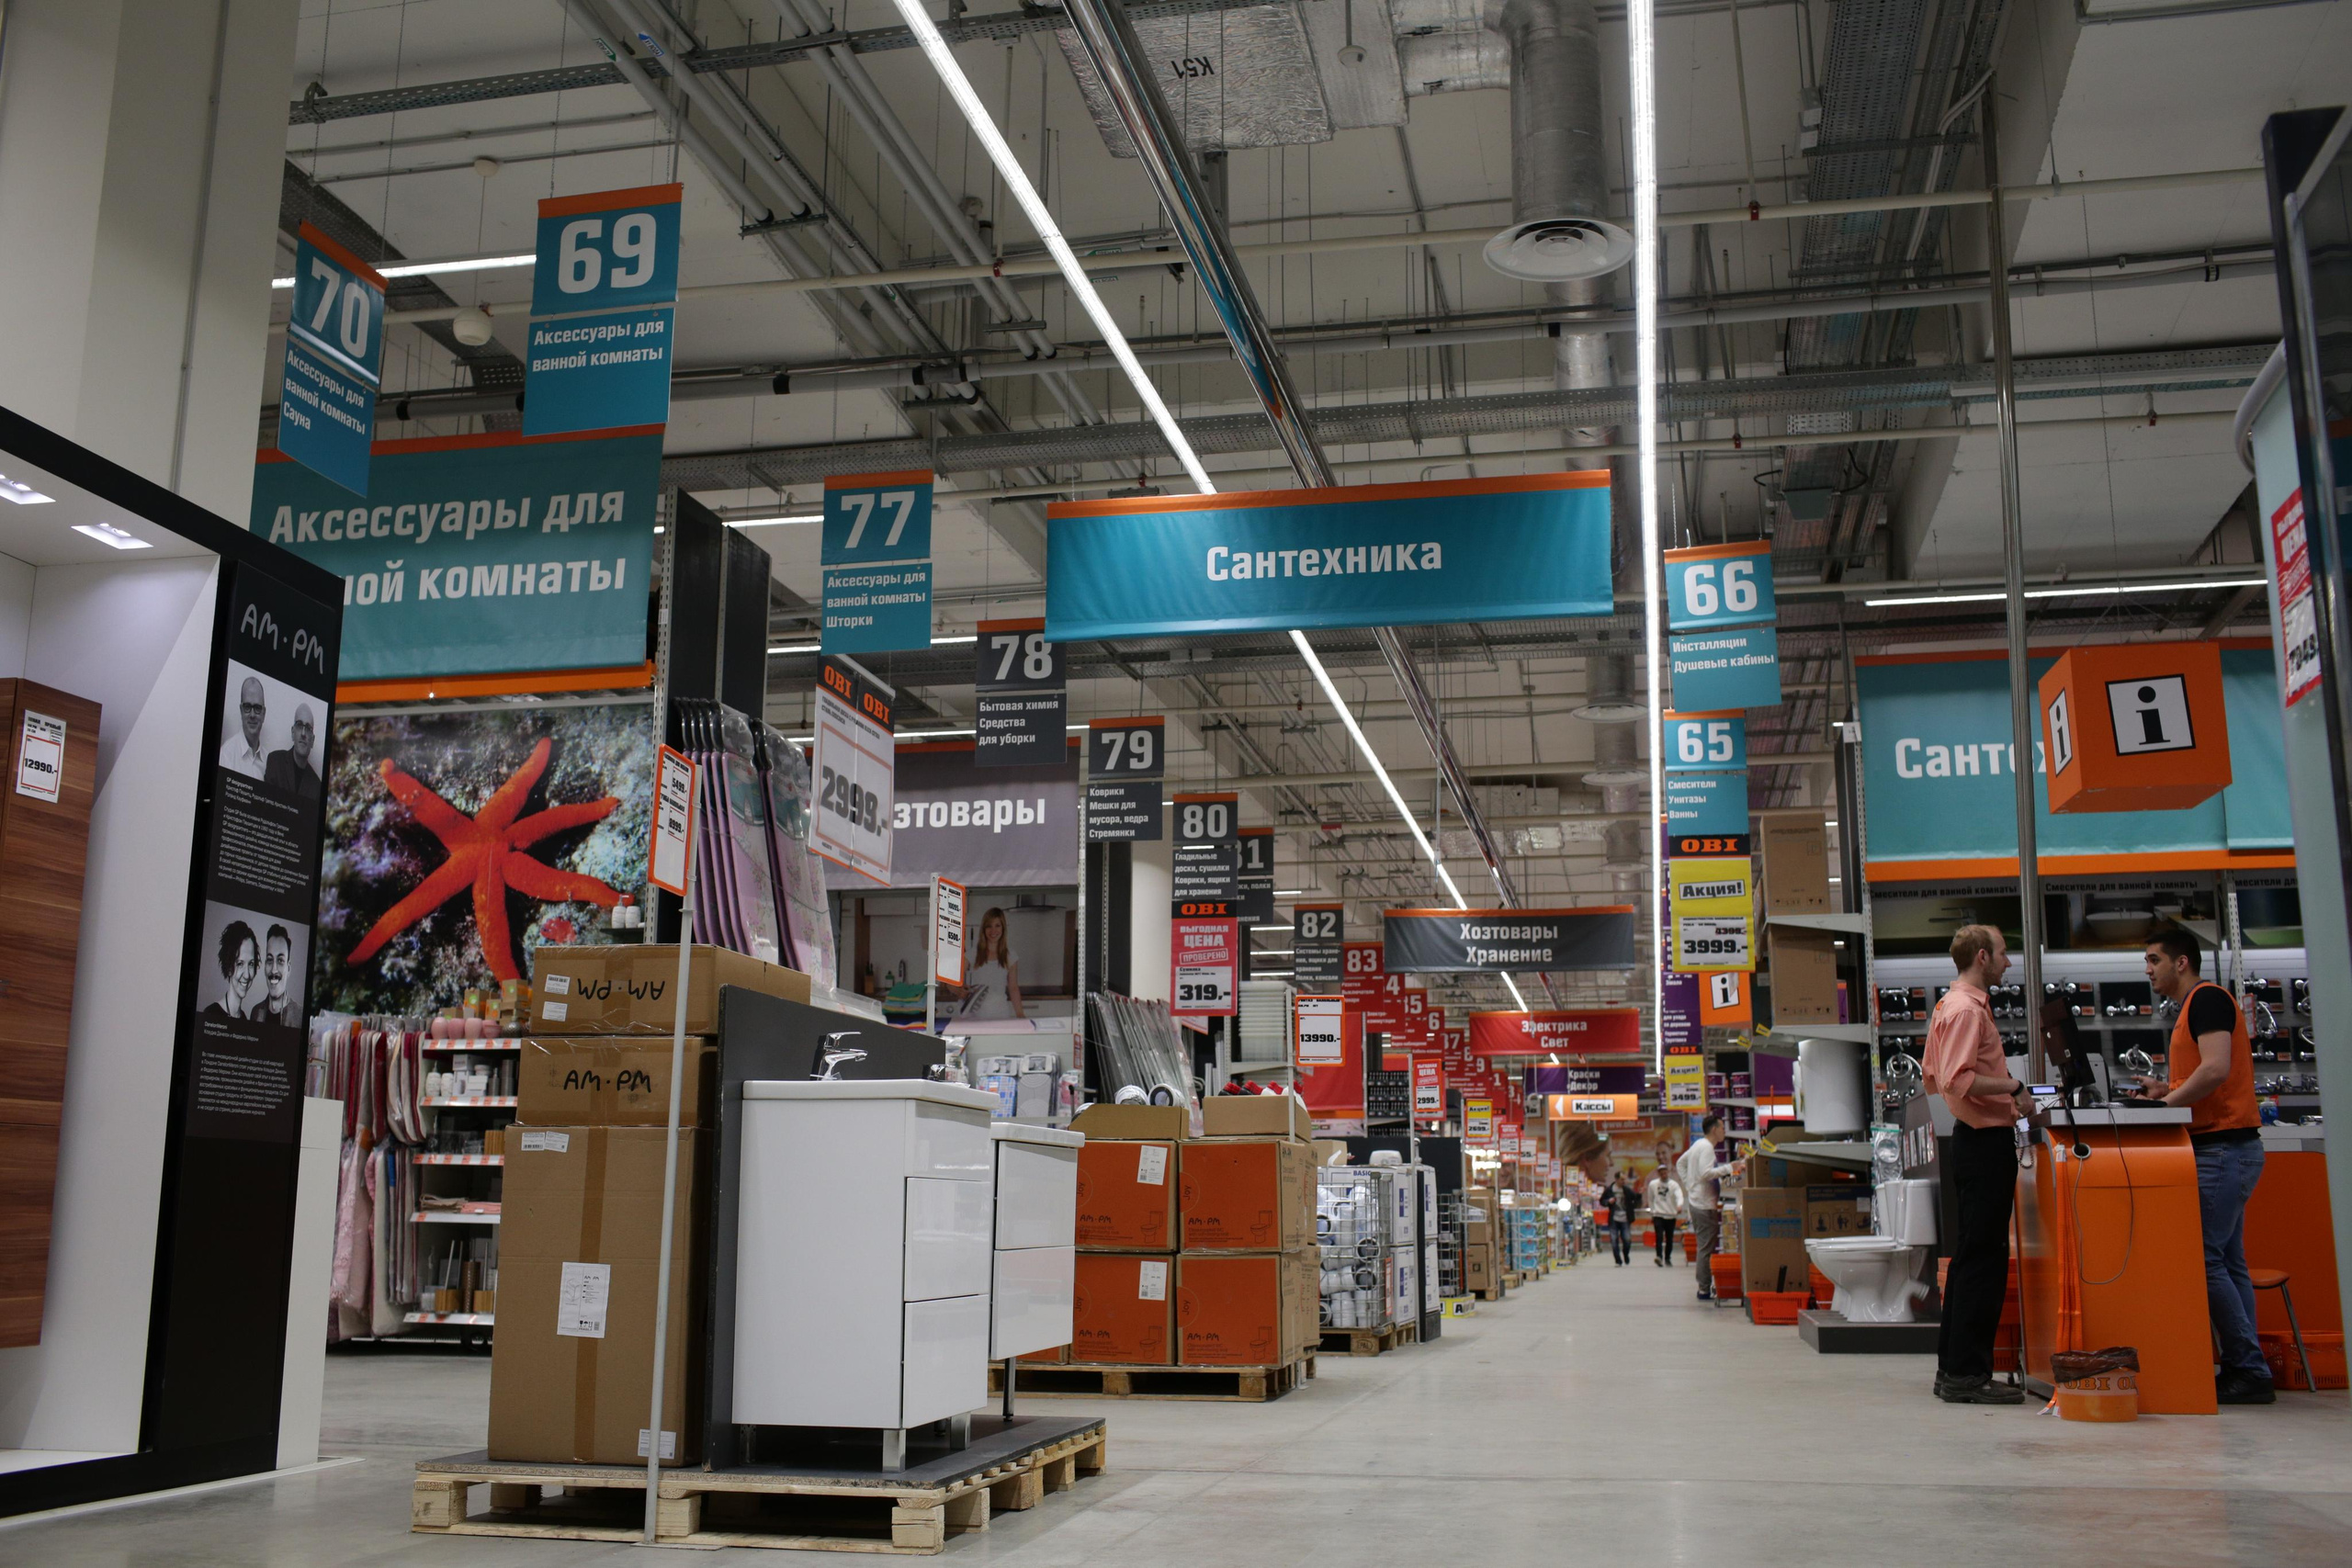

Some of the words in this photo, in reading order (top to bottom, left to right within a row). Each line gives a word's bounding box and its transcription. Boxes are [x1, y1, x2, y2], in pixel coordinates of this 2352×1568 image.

[557, 212, 657, 294] 69
[311, 256, 370, 359] 70
[533, 323, 630, 346] Аксессуары
[634, 320, 664, 338] для
[532, 348, 587, 372] ванной
[590, 345, 663, 367] комнаты
[287, 349, 345, 400] Аксессуары
[345, 388, 365, 408] для
[285, 376, 320, 408] ванной
[321, 401, 366, 435] комнаты
[283, 400, 311, 432] Сауна
[268, 497, 531, 545] Аксессуары
[541, 491, 625, 533] для
[841, 491, 915, 549] 77
[1206, 541, 1442, 582] Сантехника
[418, 558, 626, 601] комнаты
[827, 573, 900, 588] Аксессуары
[903, 571, 926, 585] для
[1683, 560, 1758, 615] 66
[827, 593, 868, 608] ванной
[871, 592, 926, 605] комнаты
[826, 615, 873, 629] Шторки
[1673, 637, 1747, 653] Инсталляции
[991, 633, 1053, 680] 78
[1674, 659, 1727, 673] Душевые
[1730, 653, 1774, 668] кабины
[824, 665, 852, 699] OBI
[864, 693, 890, 725] OBI
[979, 702, 1023, 713] Бытовая
[1025, 700, 1058, 711] химия
[979, 718, 1025, 729] Средства
[978, 736, 997, 746] для
[1000, 732, 1035, 746] уборки
[1678, 722, 1734, 762] 65
[1101, 730, 1153, 771] 79
[1090, 787, 1125, 797] Коврики
[1668, 780, 1716, 790] Смесители
[1090, 801, 1118, 810] Мешки
[1120, 800, 1136, 811] для
[1668, 795, 1706, 804] Унитазы
[894, 799, 1046, 833] зтовары
[1089, 814, 1123, 825] мусора,
[1124, 814, 1148, 824] ведра
[1182, 804, 1227, 838] 80
[1669, 810, 1698, 818] Ванны
[1089, 829, 1135, 839] Стремянки
[1681, 838, 1737, 852] OBI
[1199, 864, 1229, 873] сушилки
[1682, 881, 1743, 898] Акция!
[2045, 883, 2097, 892] Смесители
[2099, 882, 2118, 892] для
[2119, 880, 2152, 890] ванной
[2154, 880, 2198, 889] комнаты
[2234, 877, 2281, 887] месители
[1188, 888, 1222, 897] хранения
[1870, 890, 1918, 898] Смесители
[1921, 889, 1938, 898] для
[1939, 886, 1973, 896] ванной
[1975, 886, 2017, 895] комнаты
[1181, 903, 1227, 915] OBI
[1180, 925, 1228, 933] ВЫГОДНАЯ
[1302, 912, 1336, 938] 82
[1460, 923, 1558, 942] Хозтовары
[1183, 934, 1225, 948] ЦЕНА
[1182, 951, 1227, 963] ПРОВЕРЕНО
[1347, 950, 1377, 973] 83
[1466, 947, 1553, 965] Хранение
[1385, 975, 1400, 996] 4
[1521, 1020, 1588, 1034] Электрика
[1541, 1036, 1568, 1048] Свет
[1568, 1070, 1600, 1078] Краски
[1569, 1081, 1598, 1091] Декор
[1576, 1102, 1611, 1111] Кассы
[2064, 1377, 2110, 1390] OBI
